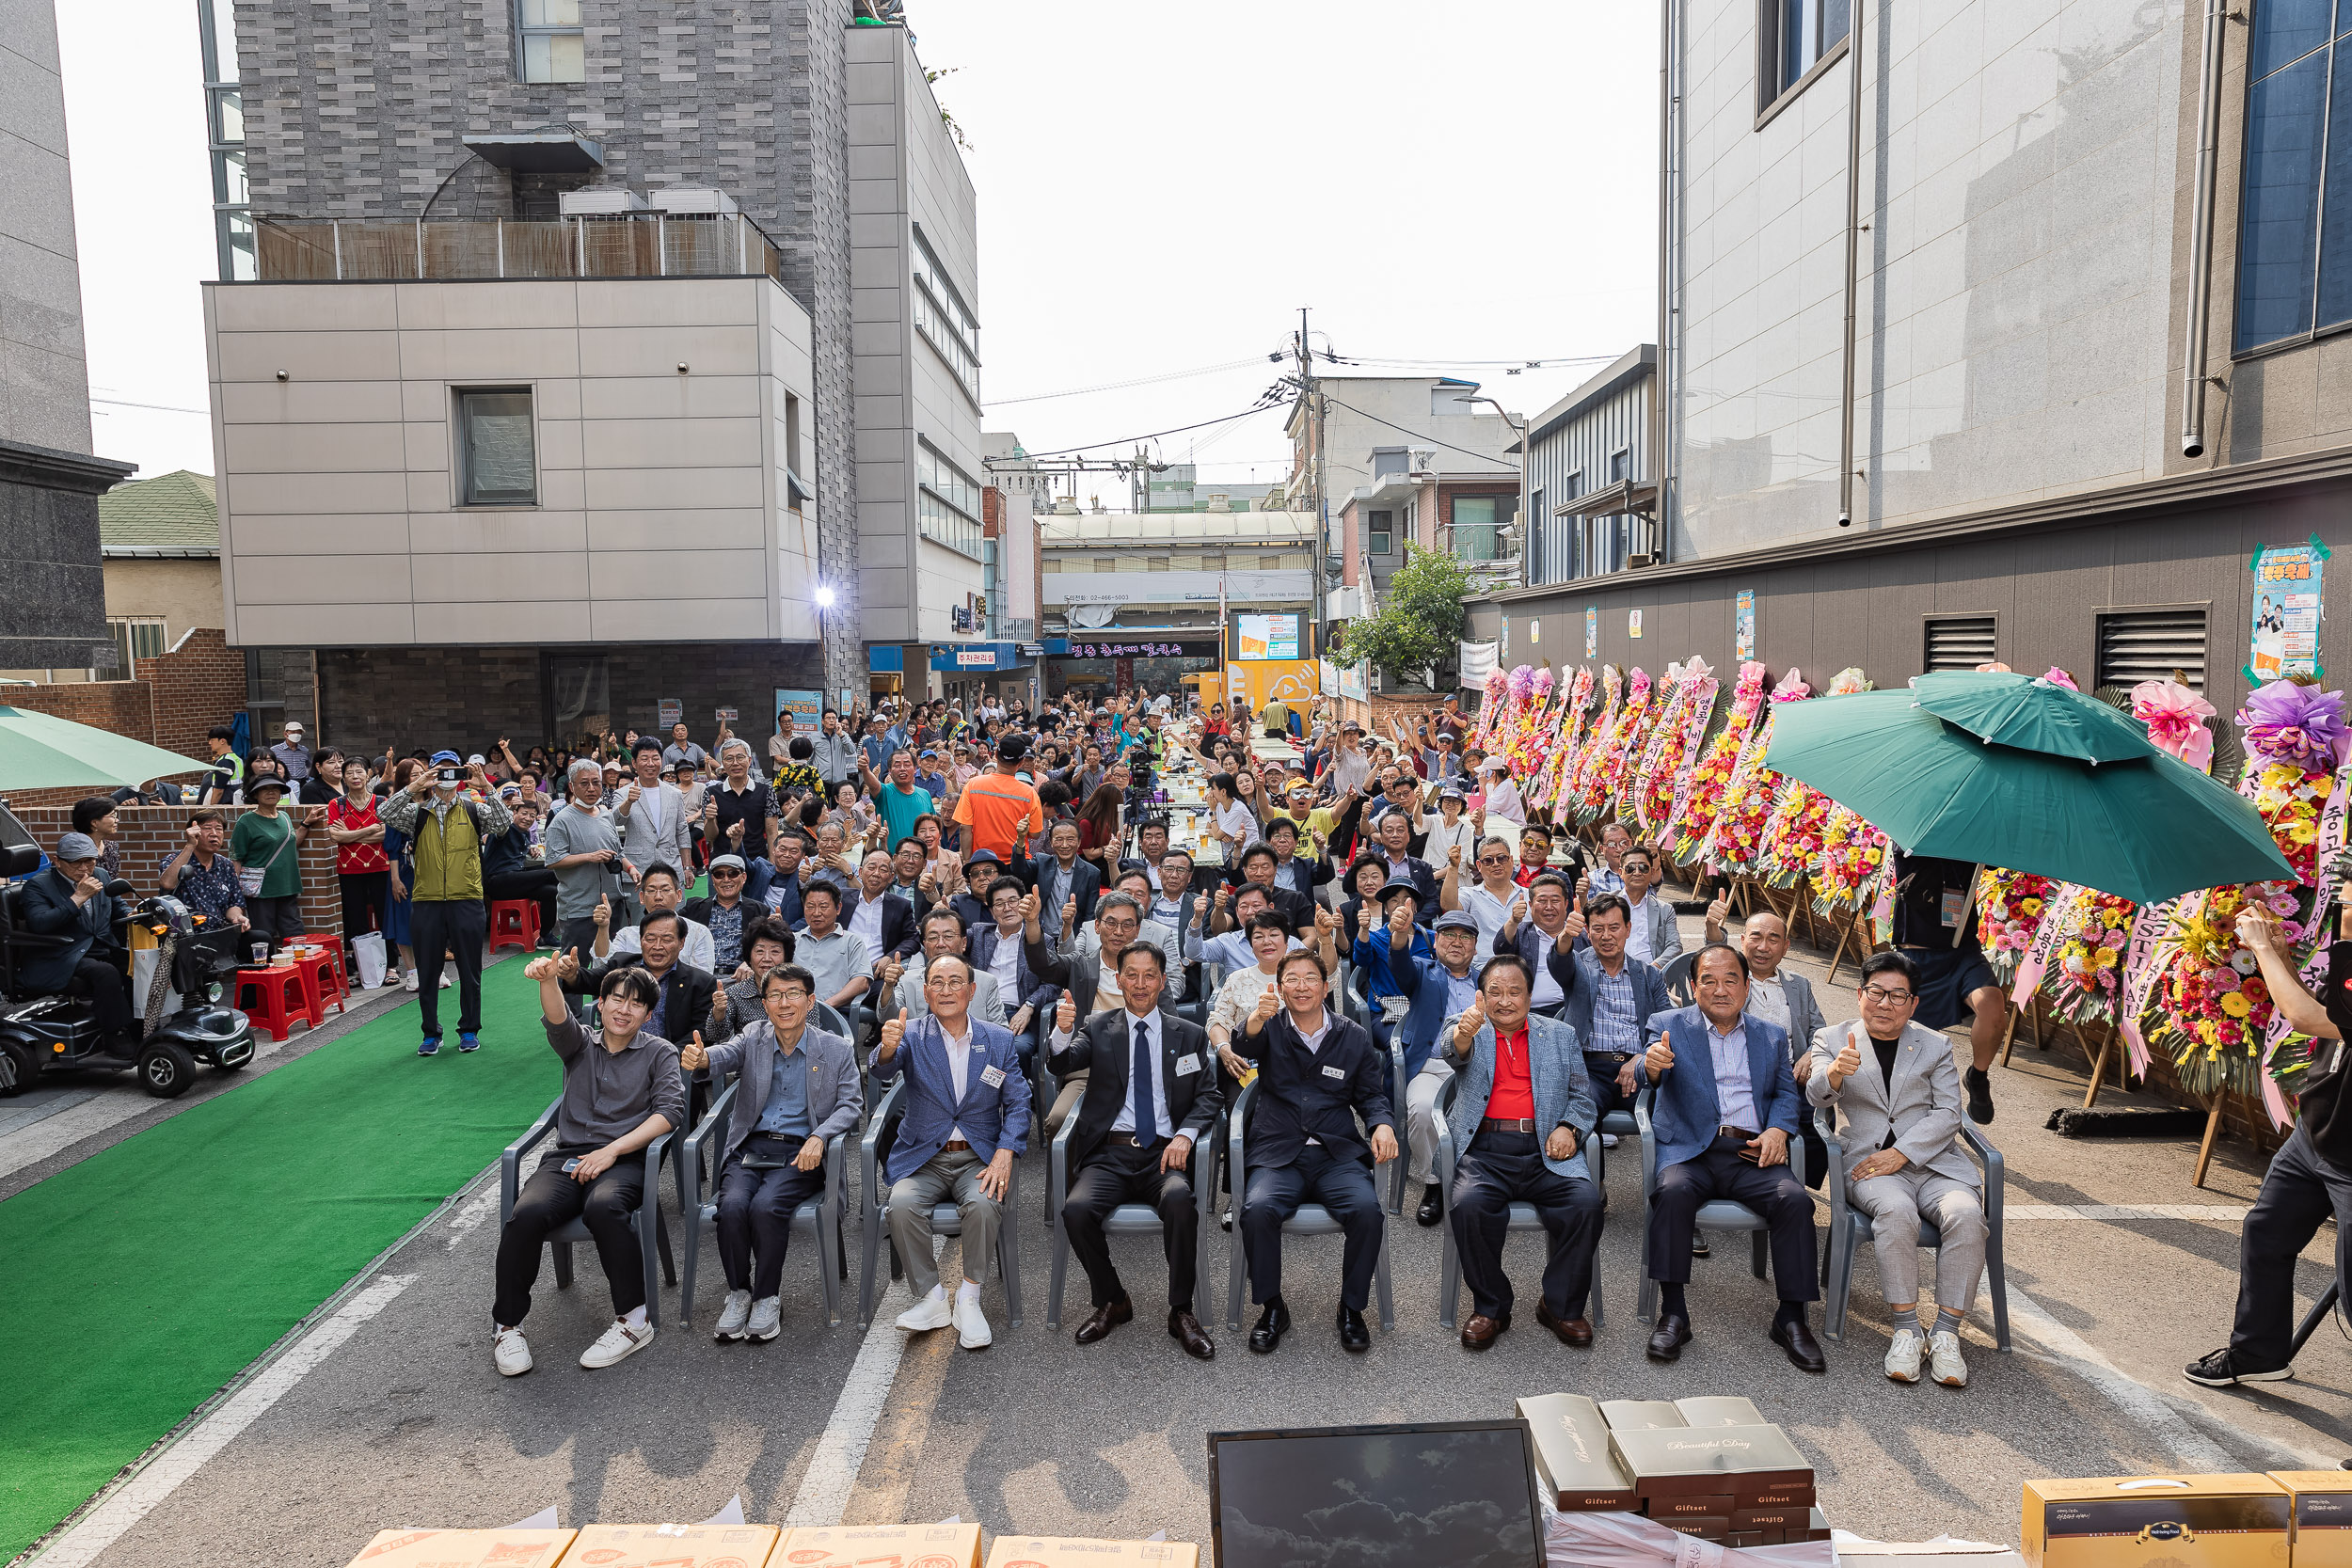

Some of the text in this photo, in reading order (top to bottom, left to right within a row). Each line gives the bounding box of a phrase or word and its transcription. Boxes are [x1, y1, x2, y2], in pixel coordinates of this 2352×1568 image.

[1140, 643, 1182, 657] 칼국수
[960, 654, 994, 663] 주차관리실
[1695, 697, 1711, 725] 앵콜
[1687, 729, 1702, 754] 비어
[1666, 1438, 1752, 1451] Beautiful Day
[1585, 1497, 1616, 1506] Giftset
[1758, 1496, 1790, 1504] Giftset
[1676, 1503, 1707, 1512] Giftset
[1752, 1515, 1785, 1524] Giftset
